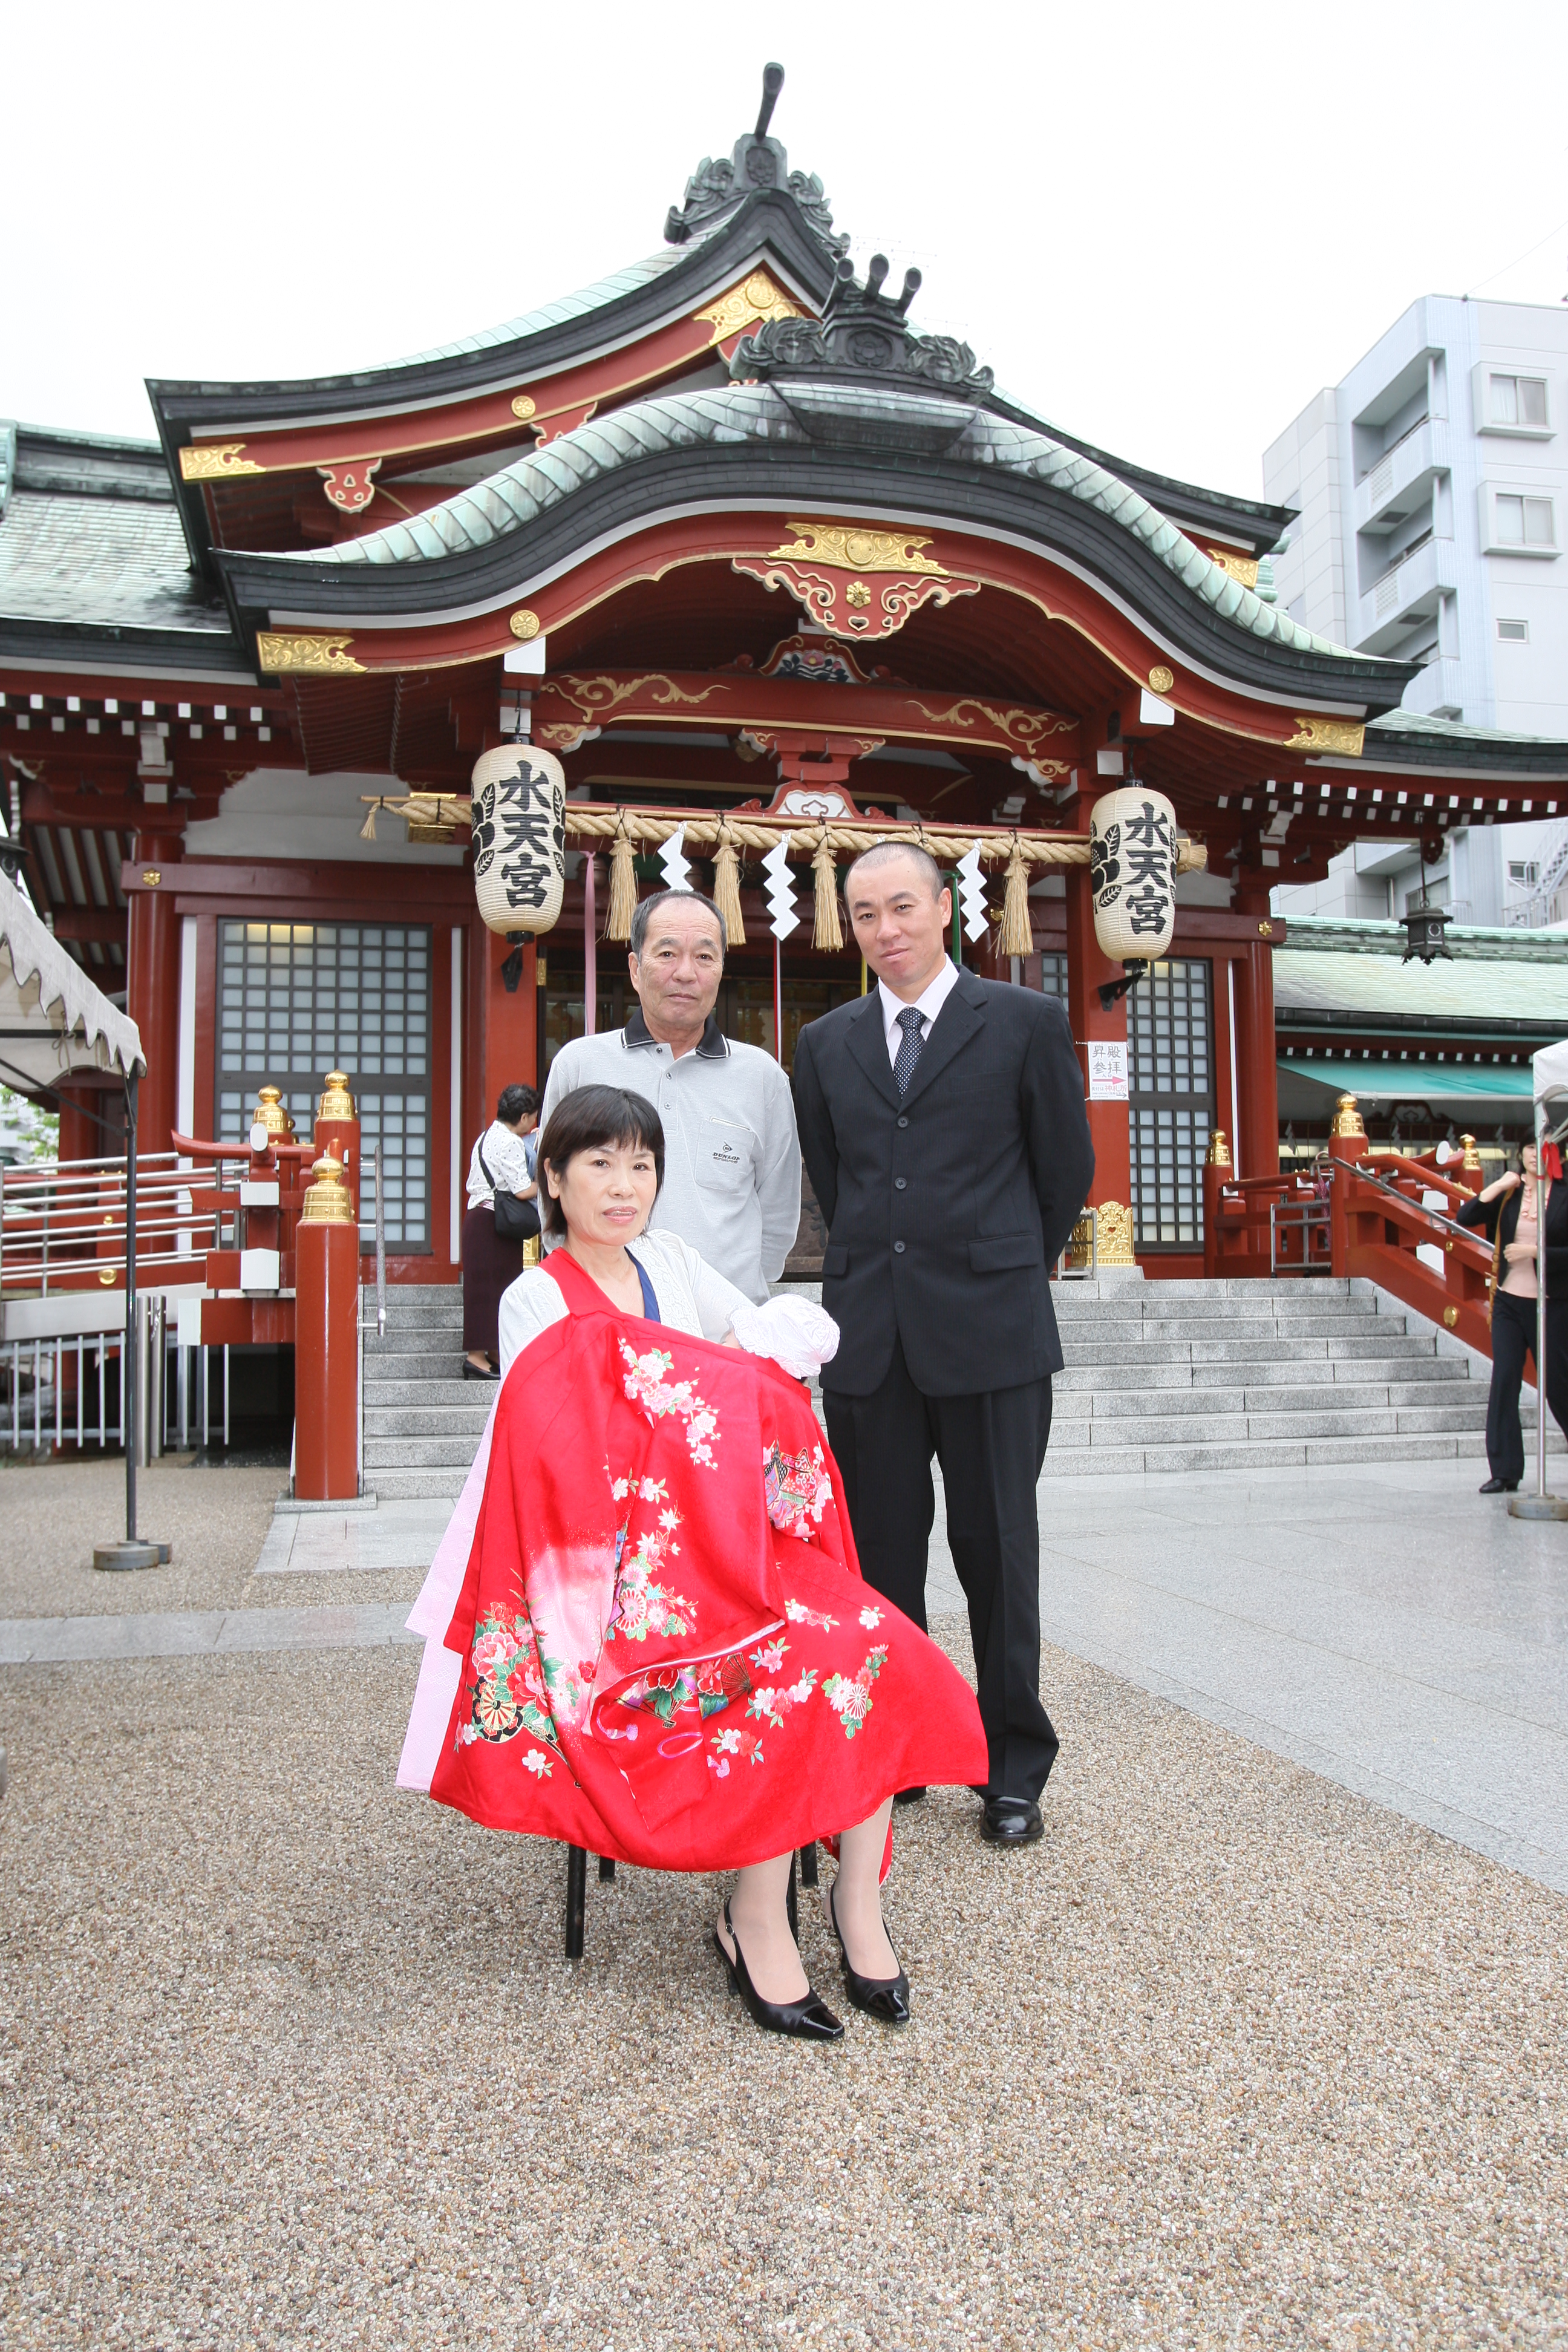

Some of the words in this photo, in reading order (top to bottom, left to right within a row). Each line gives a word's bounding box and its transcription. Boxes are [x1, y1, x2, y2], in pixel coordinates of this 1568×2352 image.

[497, 760, 552, 908] 水天宮
[1123, 802, 1169, 935] 水天宮
[1092, 1045, 1121, 1058] 昇殿
[1093, 1061, 1122, 1074] 参拝
[713, 1152, 740, 1160] DUNLOP
